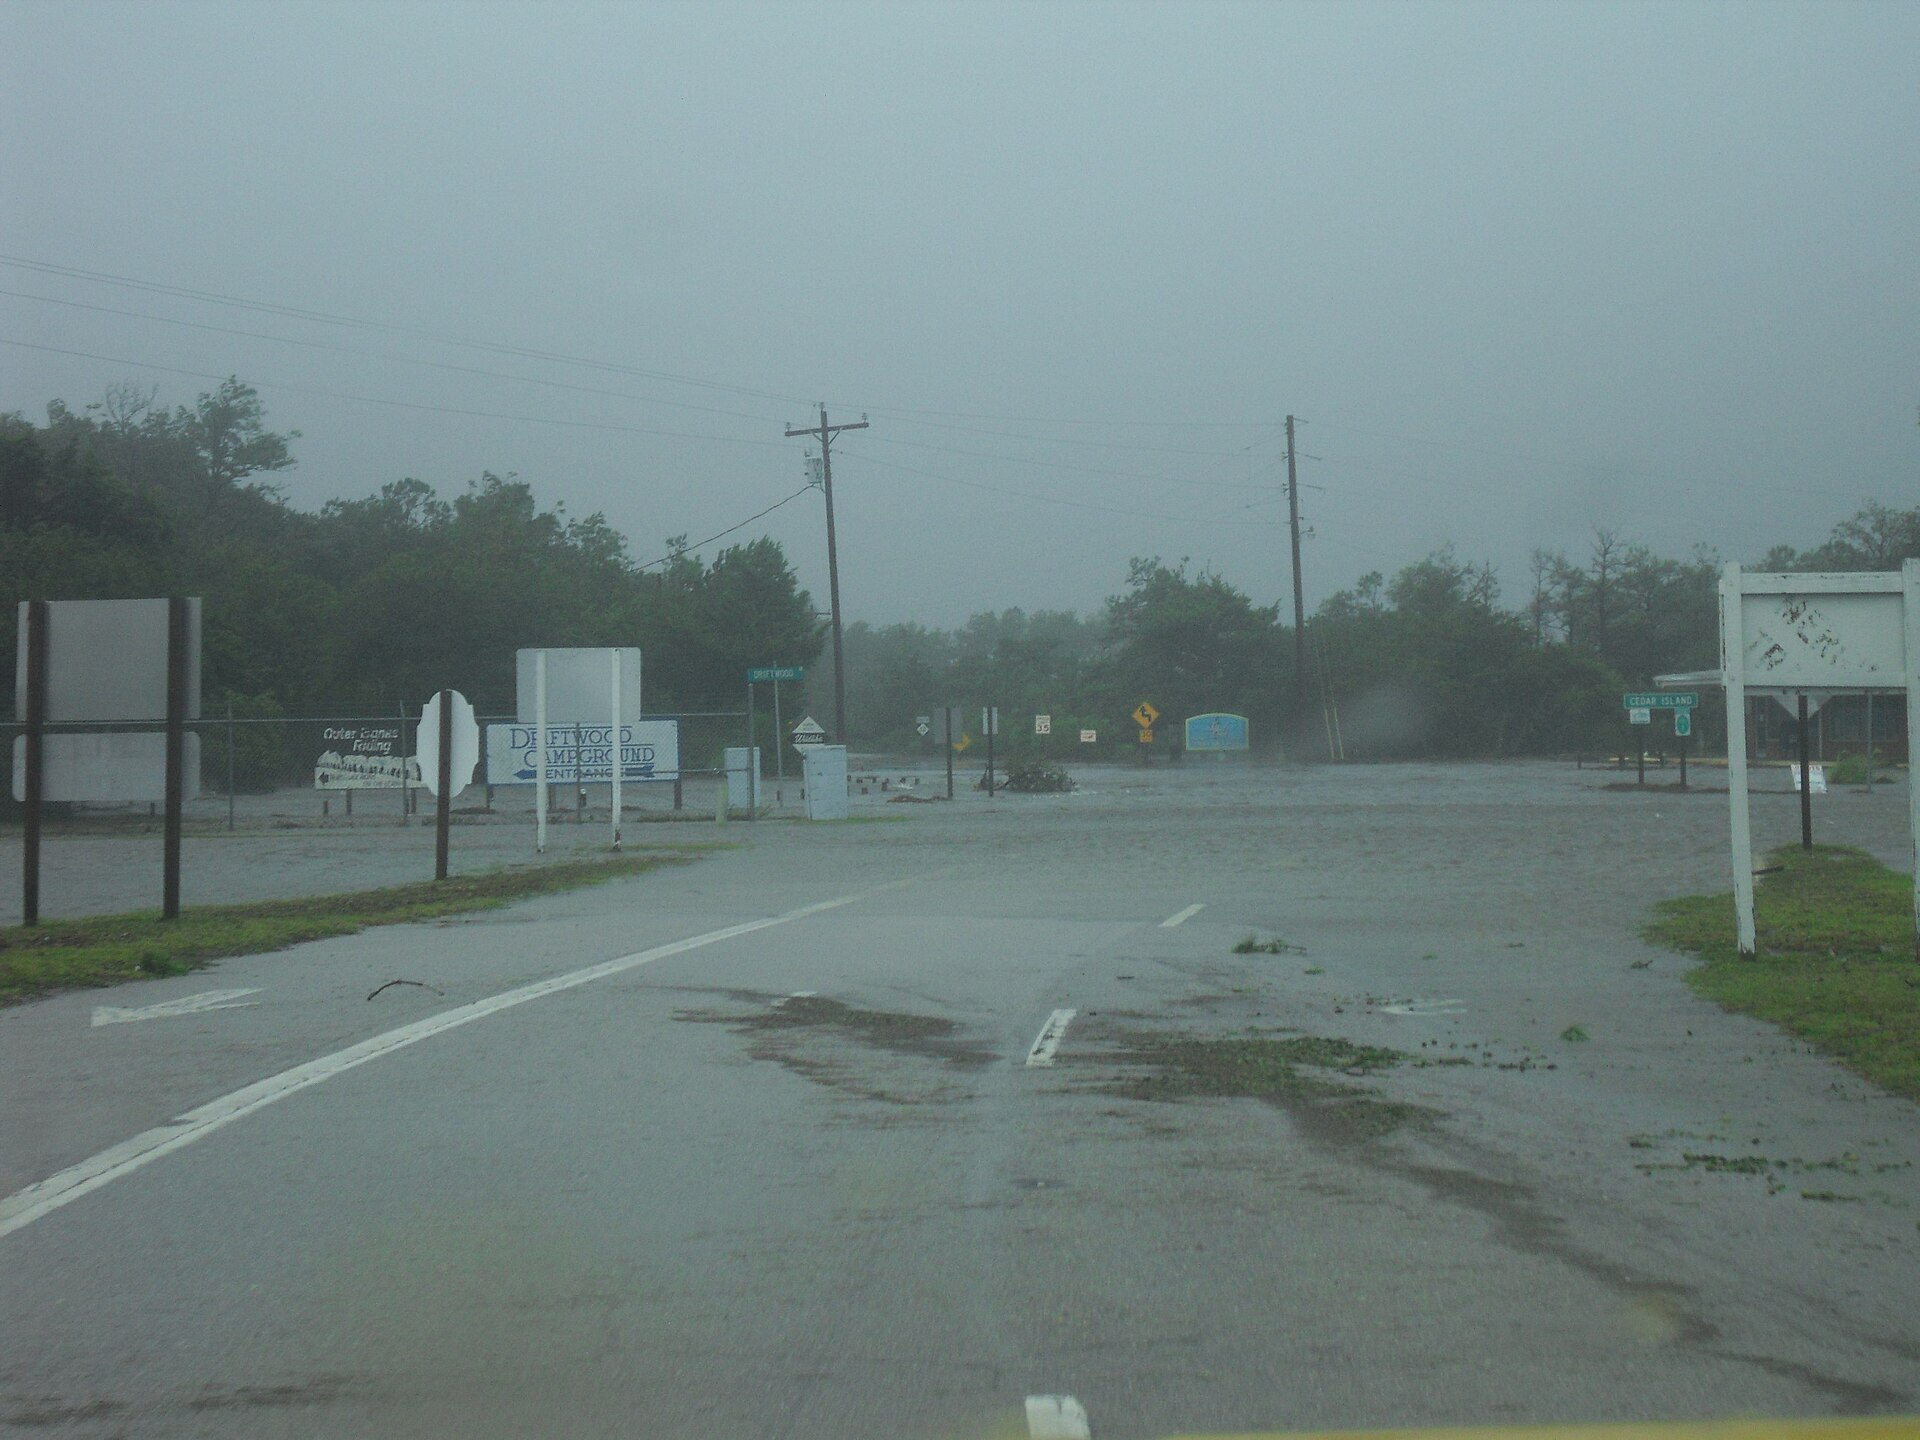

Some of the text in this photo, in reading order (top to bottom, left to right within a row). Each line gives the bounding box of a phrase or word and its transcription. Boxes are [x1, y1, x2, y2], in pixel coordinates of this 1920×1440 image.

[1629, 695, 1693, 706] CEDAR ISLAND
[323, 727, 357, 739] Outer
